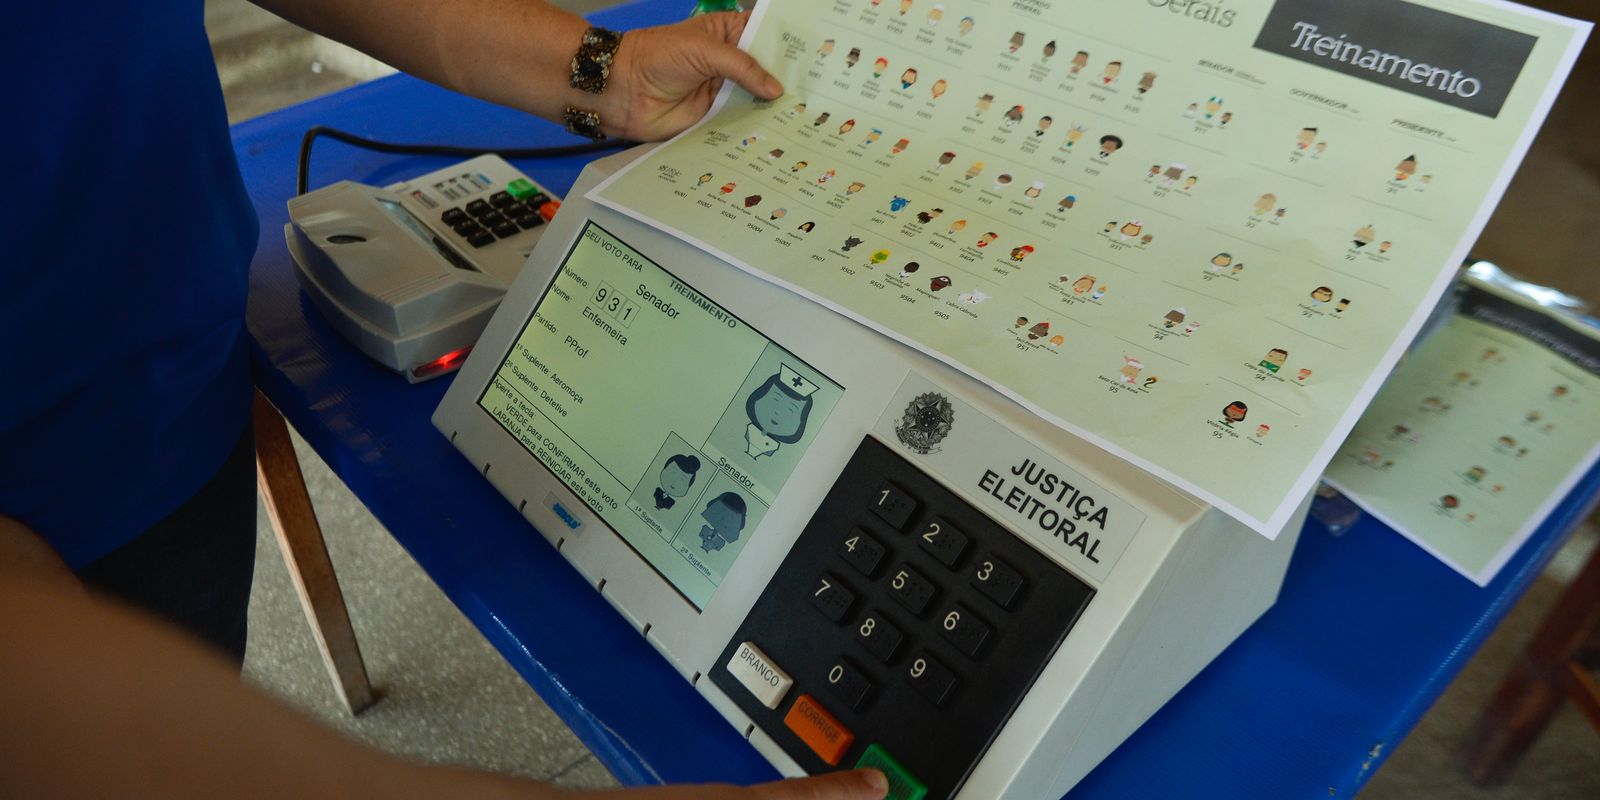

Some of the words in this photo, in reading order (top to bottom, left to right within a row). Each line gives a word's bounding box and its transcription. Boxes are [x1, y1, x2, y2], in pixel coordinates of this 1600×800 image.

[1291, 20, 1482, 98] Treinamento
[720, 210, 736, 220] 95003
[747, 222, 763, 232] 95004
[585, 229, 601, 244] SEU
[600, 241, 622, 258] VOTO
[622, 254, 642, 272] PARA
[960, 254, 975, 262] 9404
[840, 266, 856, 276] 9502
[870, 280, 886, 290] 9503
[596, 288, 632, 320] 931
[636, 284, 680, 320] Senador
[670, 280, 736, 328] TREINAMENTO
[900, 294, 916, 304] 9504
[552, 284, 572, 303] Nome:
[582, 306, 628, 346] Enfermeira
[934, 310, 951, 320] 9505
[564, 335, 589, 358] PProf
[1016, 343, 1030, 352] 951
[1255, 372, 1266, 382] 94
[494, 378, 513, 400] Aperte
[550, 373, 584, 404] Aeromoça
[1108, 386, 1119, 394] 95
[540, 390, 568, 417] Detetive
[1212, 430, 1224, 440] 95
[492, 406, 522, 437] LARANJA
[520, 434, 536, 452] para
[536, 447, 572, 483] REINICIAR
[570, 480, 587, 497] este
[588, 495, 604, 512] voto
[506, 403, 528, 427] VERDE
[526, 424, 548, 442] para
[543, 437, 586, 480] CONFIRMAR
[584, 476, 601, 494] este
[602, 492, 618, 510] voto
[718, 456, 755, 490] Senador
[878, 490, 890, 506] 1
[1011, 458, 1108, 531] JUSTIÇA
[641, 510, 664, 534] Suplente
[978, 468, 1100, 564] ELEITORAL
[922, 524, 940, 543] 2
[844, 536, 860, 553] 4
[688, 552, 712, 577] Suplente
[977, 561, 994, 580] 3
[814, 580, 831, 598] 7
[892, 571, 909, 589] 5
[860, 618, 875, 636] 8
[943, 611, 959, 630] 6
[740, 647, 780, 688] BRANCO
[828, 664, 844, 684] 0
[910, 658, 926, 678] 9
[798, 701, 842, 744] CORRIGE
